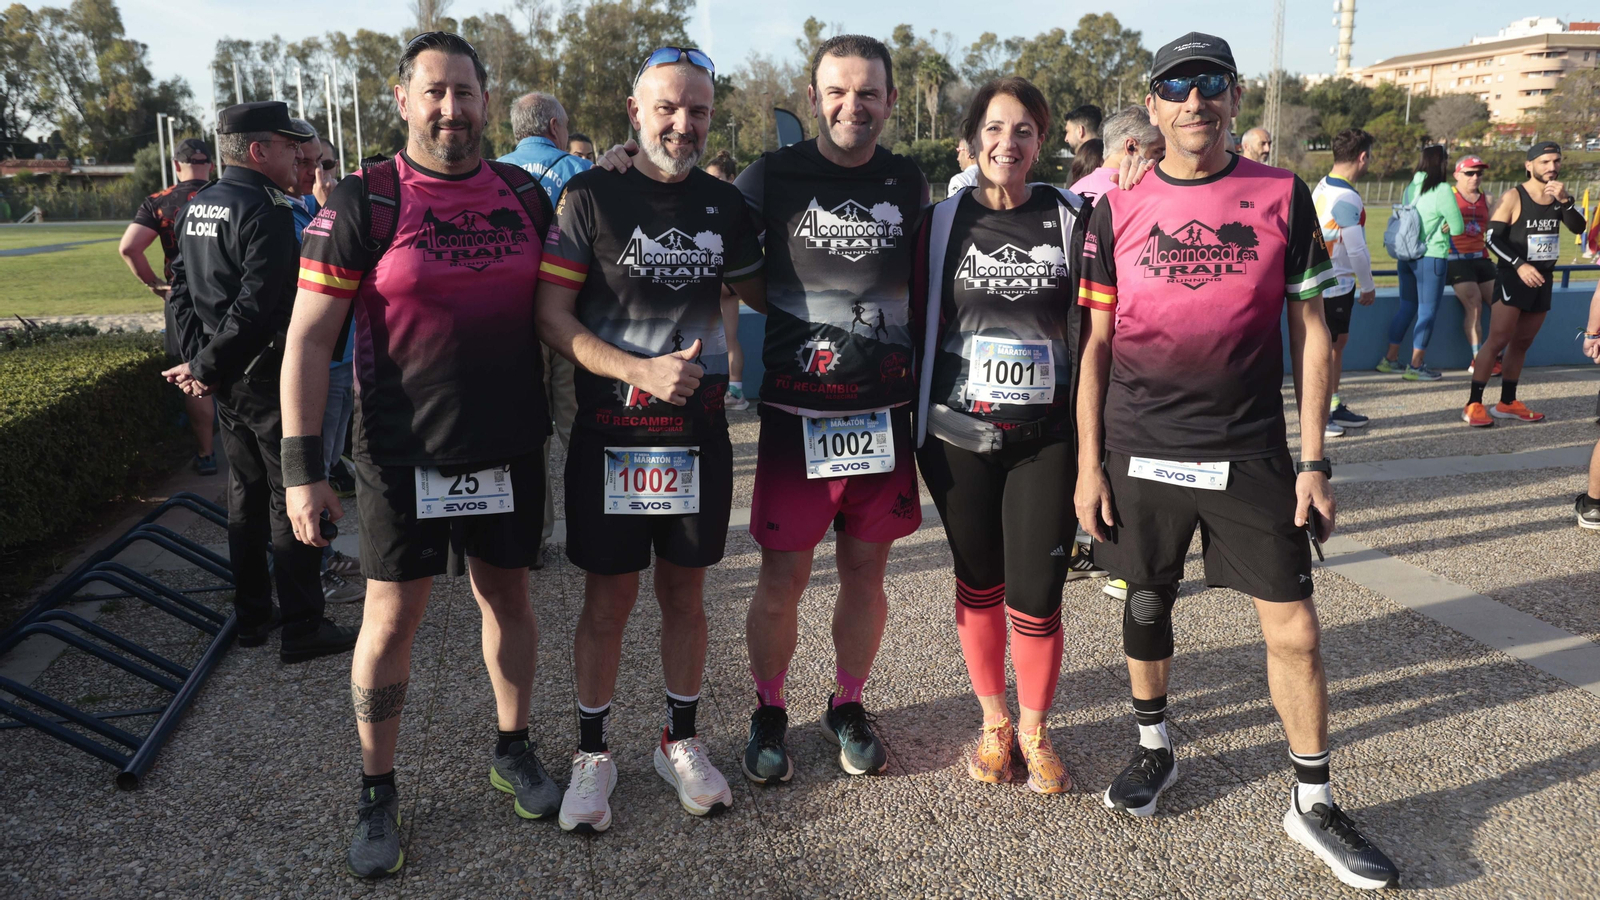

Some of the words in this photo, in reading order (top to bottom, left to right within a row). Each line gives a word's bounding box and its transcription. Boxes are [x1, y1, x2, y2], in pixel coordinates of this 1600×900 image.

[520, 162, 563, 189] TAMIENTO
[187, 204, 230, 222] POLICIA
[1526, 219, 1537, 229] LA
[1538, 218, 1559, 229] SECT
[810, 238, 895, 248] TRAIL
[1536, 242, 1553, 253] 226
[428, 246, 521, 260] TRAIL
[450, 259, 504, 268] RUNNING
[633, 266, 716, 276] TRAIL
[1148, 264, 1243, 277] TRAIL
[967, 278, 1057, 288] TRAIL
[997, 345, 1032, 357] MARATÓN
[982, 358, 1036, 386] 1001
[775, 378, 790, 390] TU
[793, 381, 859, 394] RECAMBIO
[989, 390, 1030, 401] EVOS
[596, 413, 610, 424] TU
[613, 416, 684, 426] RECAMBIO
[818, 430, 875, 458] 1002
[633, 454, 671, 464] MARATÓN
[829, 461, 870, 472] EVOS
[618, 467, 678, 493] 1002
[1153, 468, 1197, 482] EVOS
[447, 472, 480, 495] 25
[443, 501, 488, 512] EVOS
[628, 501, 672, 510] EVOS
